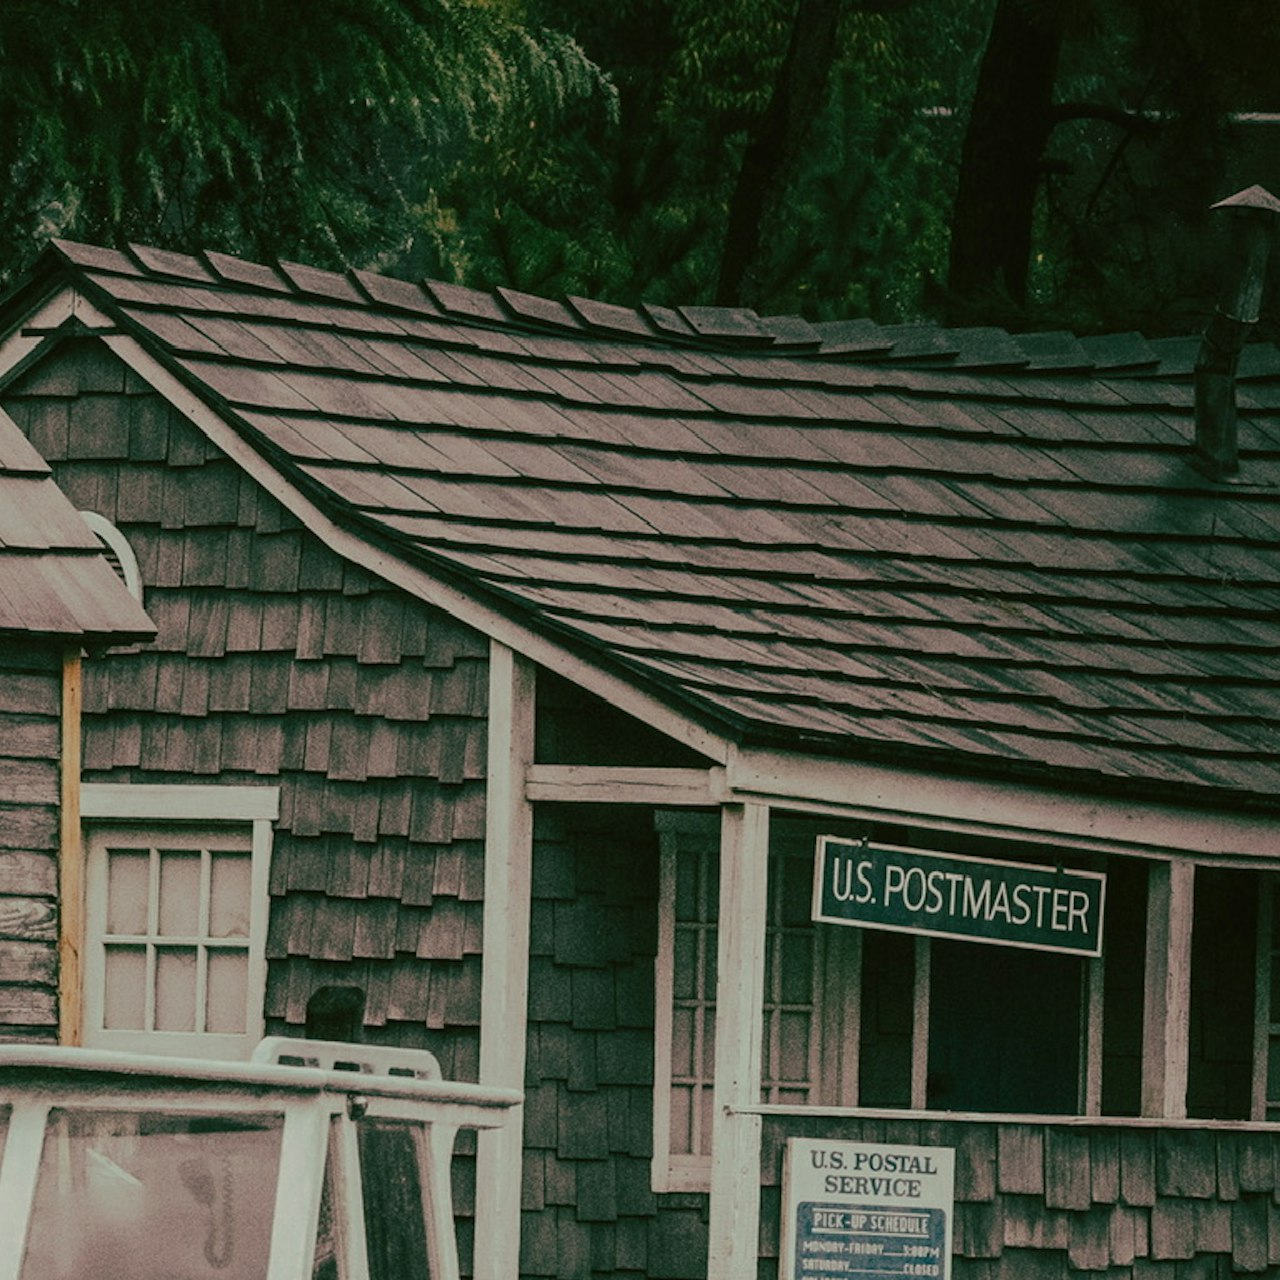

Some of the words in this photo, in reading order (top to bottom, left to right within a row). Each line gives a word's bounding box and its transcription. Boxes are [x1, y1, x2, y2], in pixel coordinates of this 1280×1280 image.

[832, 857, 876, 904] U.S.
[884, 865, 1090, 934] POSTMASTER
[811, 1150, 847, 1170] U.S.
[854, 1152, 937, 1175] POSTAL
[825, 1175, 921, 1198] SERVICE
[814, 1212, 867, 1231] PICK-UP
[870, 1216, 929, 1234] SCHEDULE
[801, 1258, 850, 1271] SATURDAY
[903, 1263, 939, 1276] CLOSED
